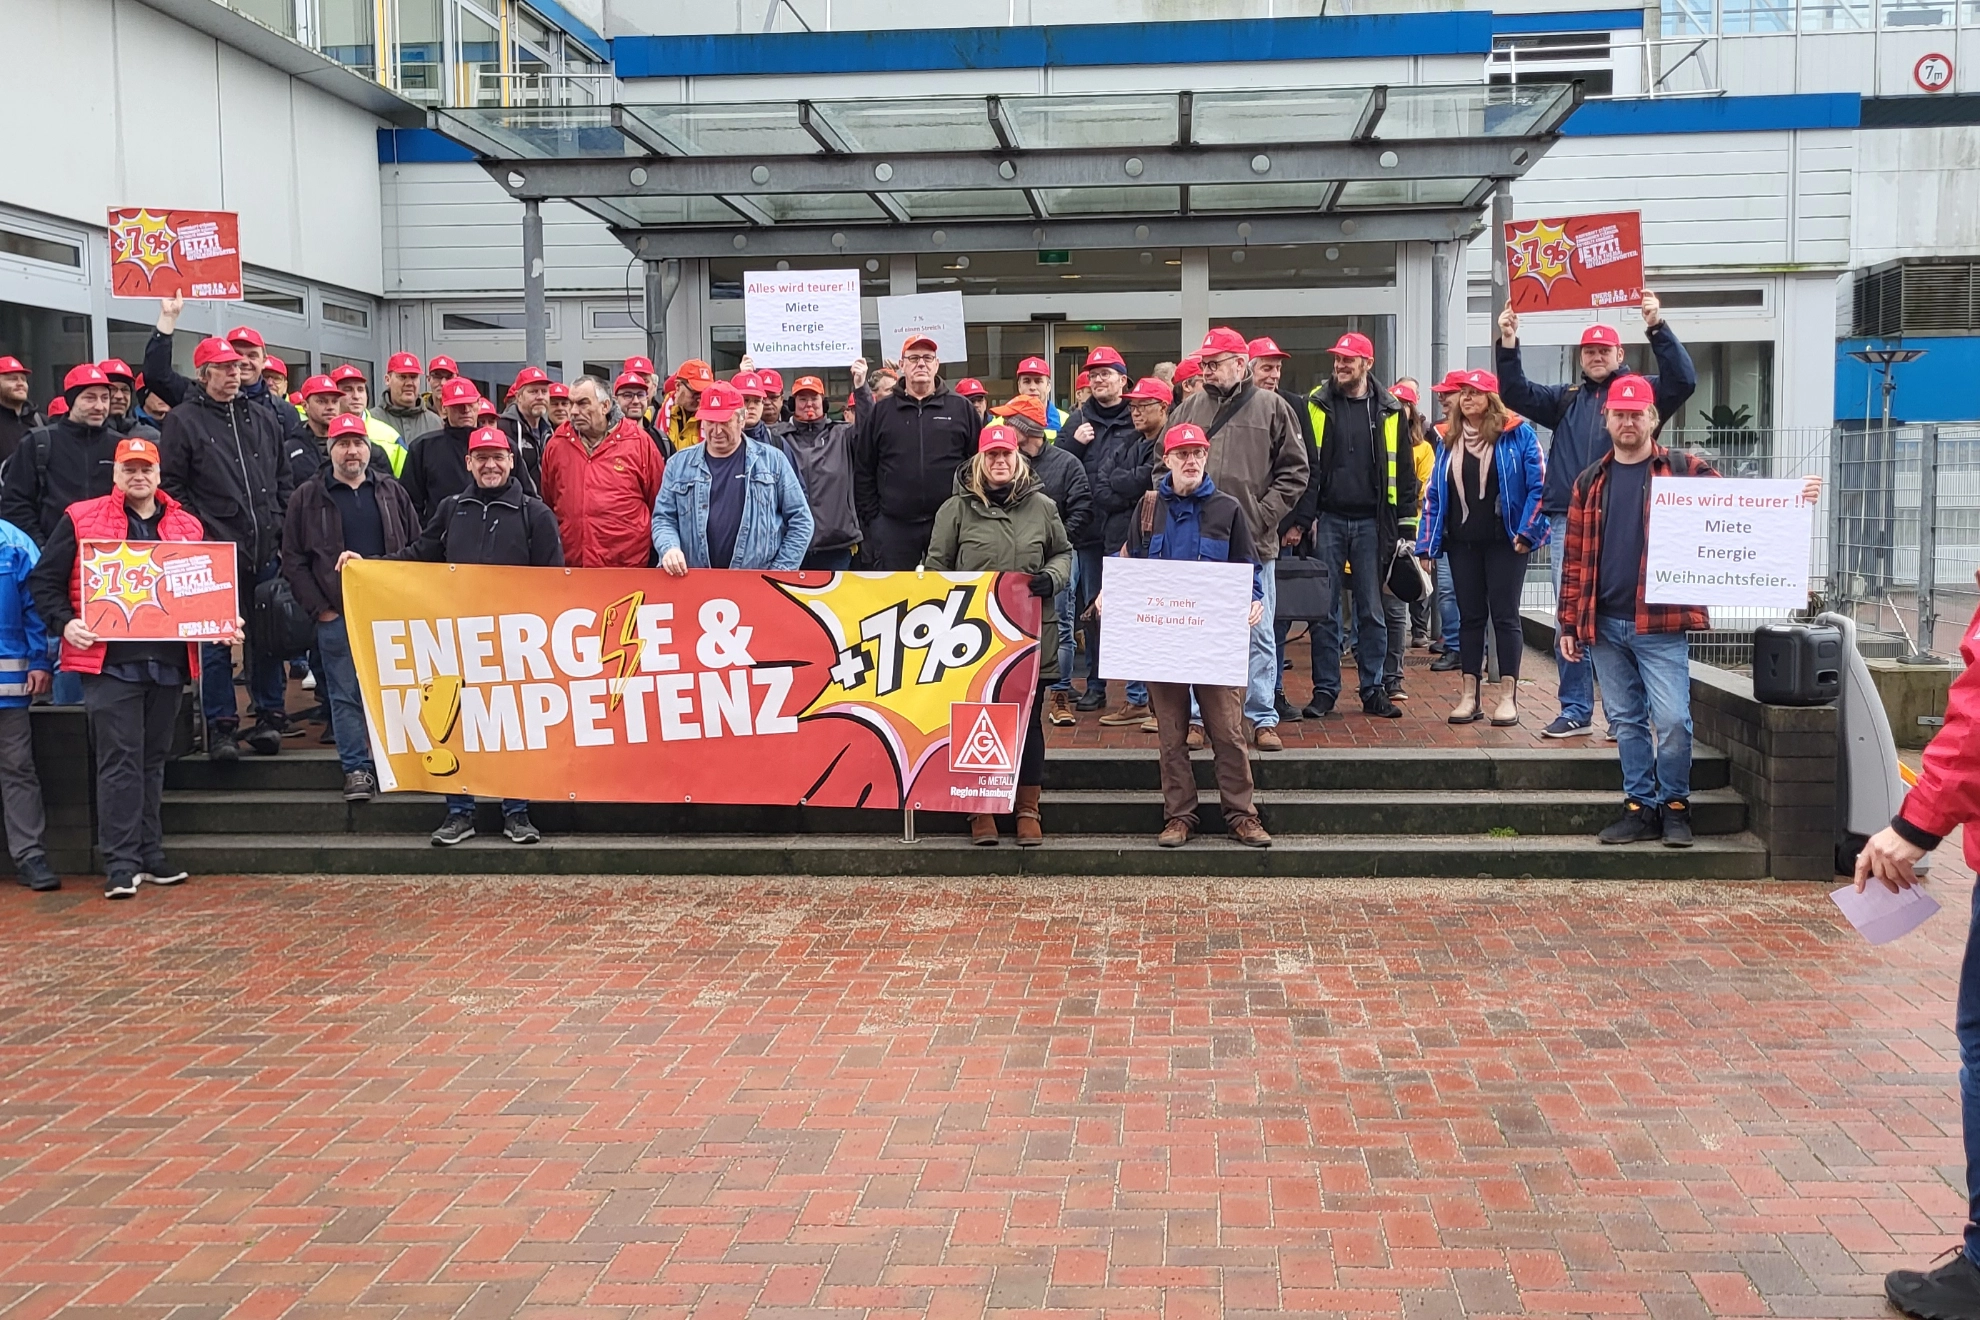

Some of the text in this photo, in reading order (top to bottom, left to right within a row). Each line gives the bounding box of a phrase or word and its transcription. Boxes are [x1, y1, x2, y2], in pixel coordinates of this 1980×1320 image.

[1578, 238, 1620, 263] JETZT!
[748, 281, 855, 294] Alles wird teurer !!
[785, 302, 819, 313] Miete
[781, 322, 824, 334] Energie
[921, 324, 941, 332] Streich
[753, 340, 854, 353] Weihnachtsfeier..
[1655, 492, 1805, 509] Alles wird teurer !!
[1705, 520, 1752, 534] Miete
[1697, 546, 1757, 562] Energie
[166, 568, 213, 592] JETZT!
[1655, 570, 1797, 587] Weihnachtsfeier..
[1147, 597, 1197, 608] 7 % mehr
[1136, 613, 1205, 626] Nötig und fair
[695, 598, 757, 668] &
[979, 776, 1014, 786] IG METALL
[950, 786, 1013, 800] Region Hamburg
